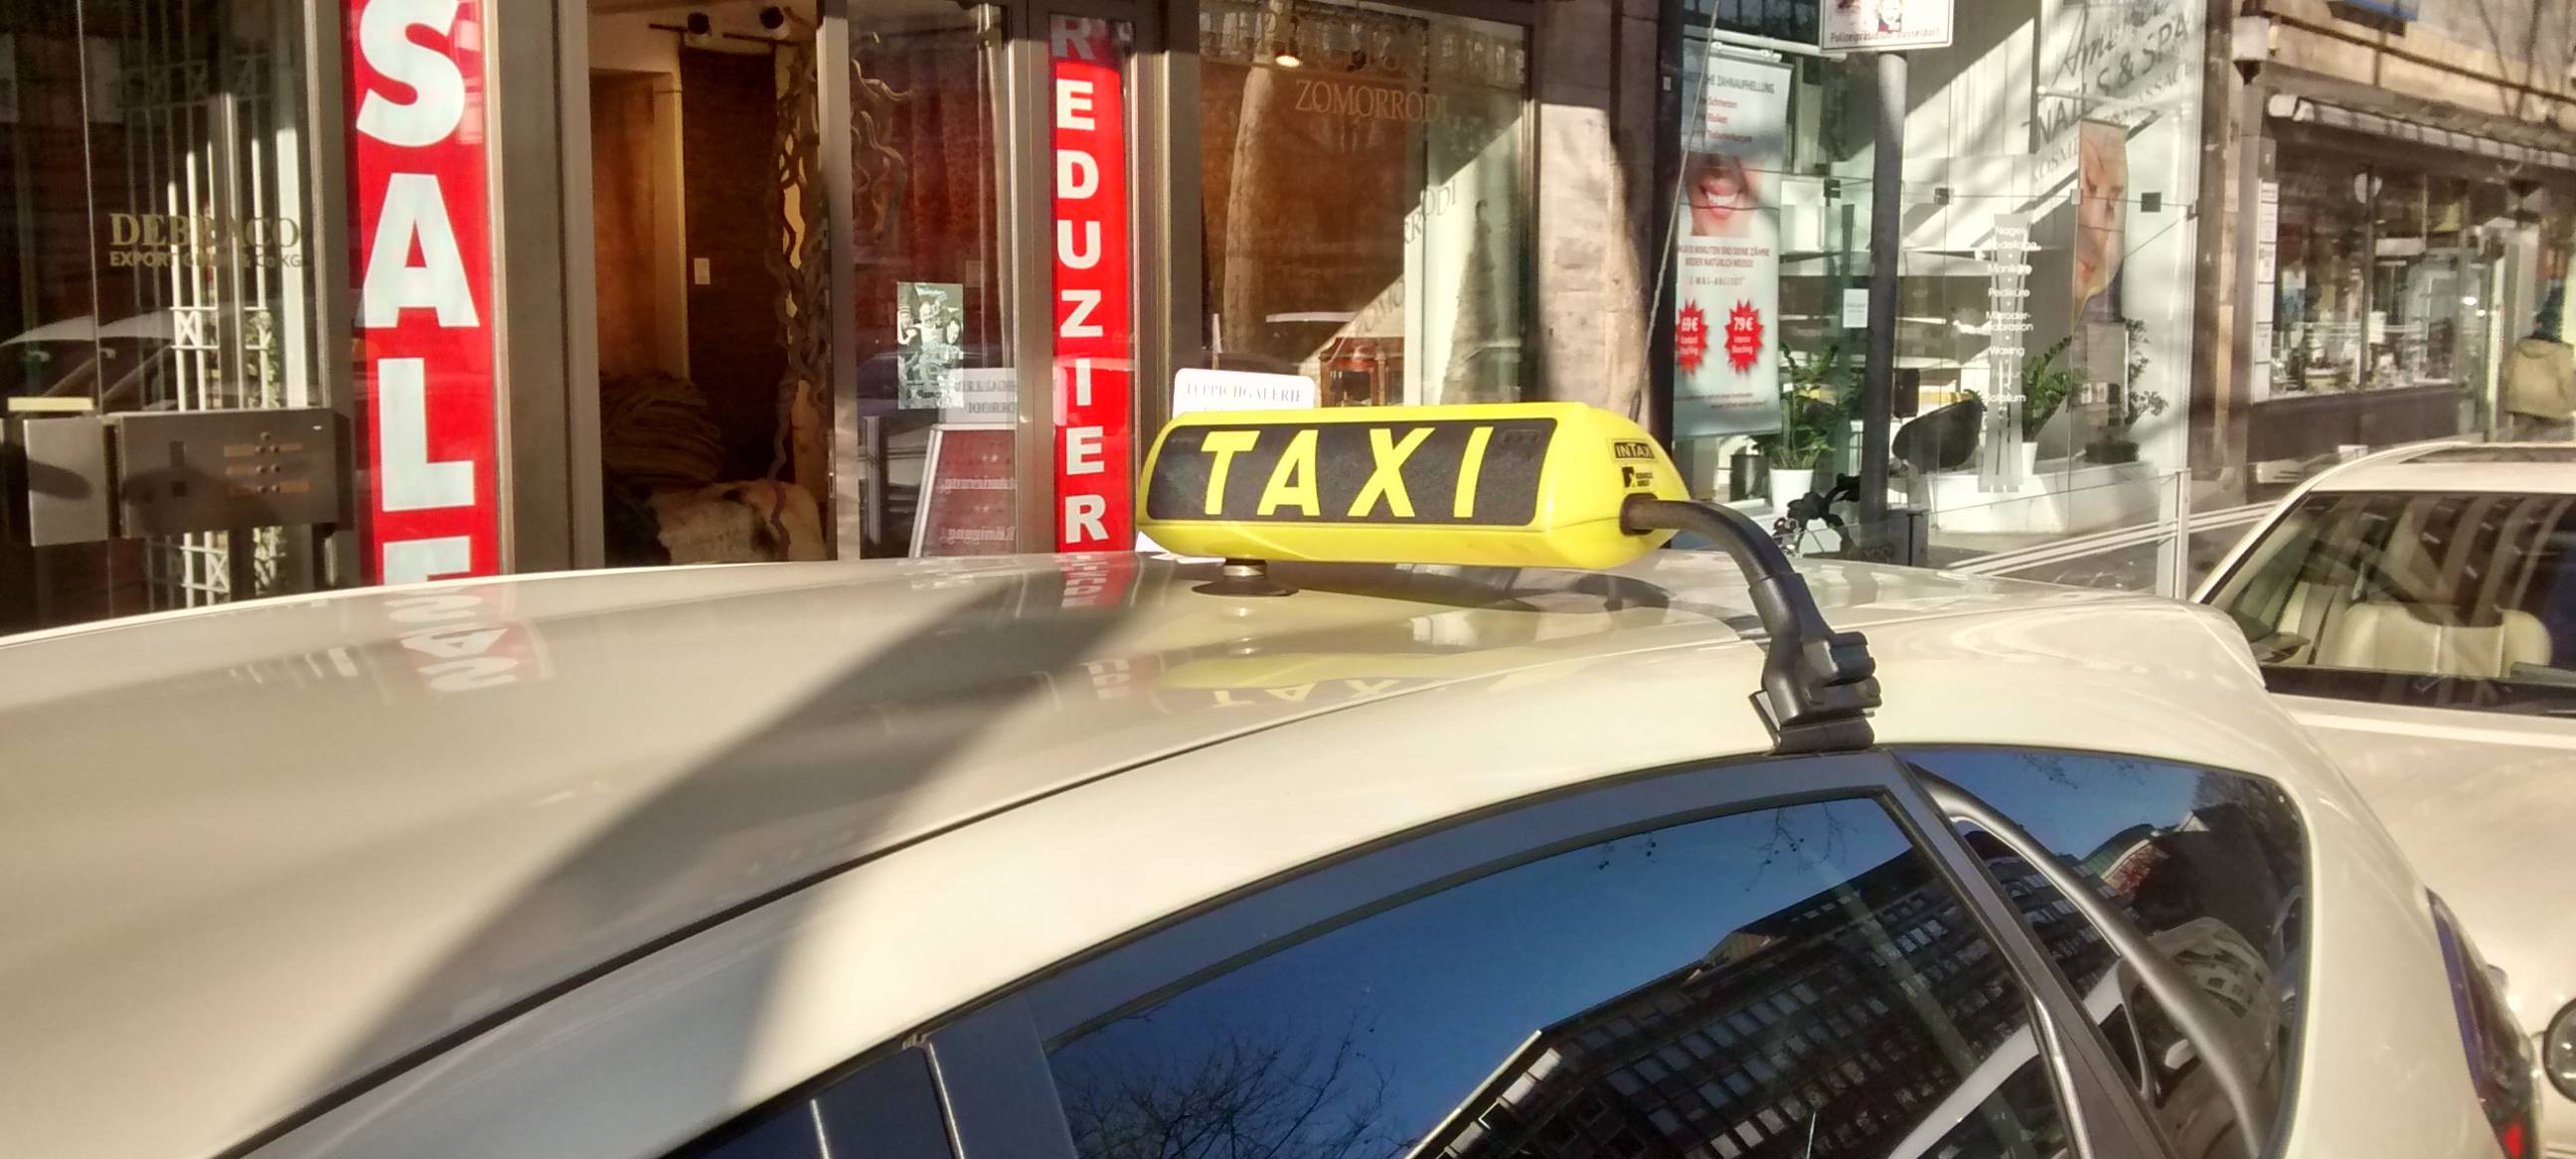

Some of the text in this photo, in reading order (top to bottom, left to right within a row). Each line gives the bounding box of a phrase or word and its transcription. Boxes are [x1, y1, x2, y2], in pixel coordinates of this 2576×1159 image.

[1295, 80, 1448, 124] ZOMORRODI
[1201, 426, 1494, 518] TAXI
[1616, 443, 1653, 458] INTAX
